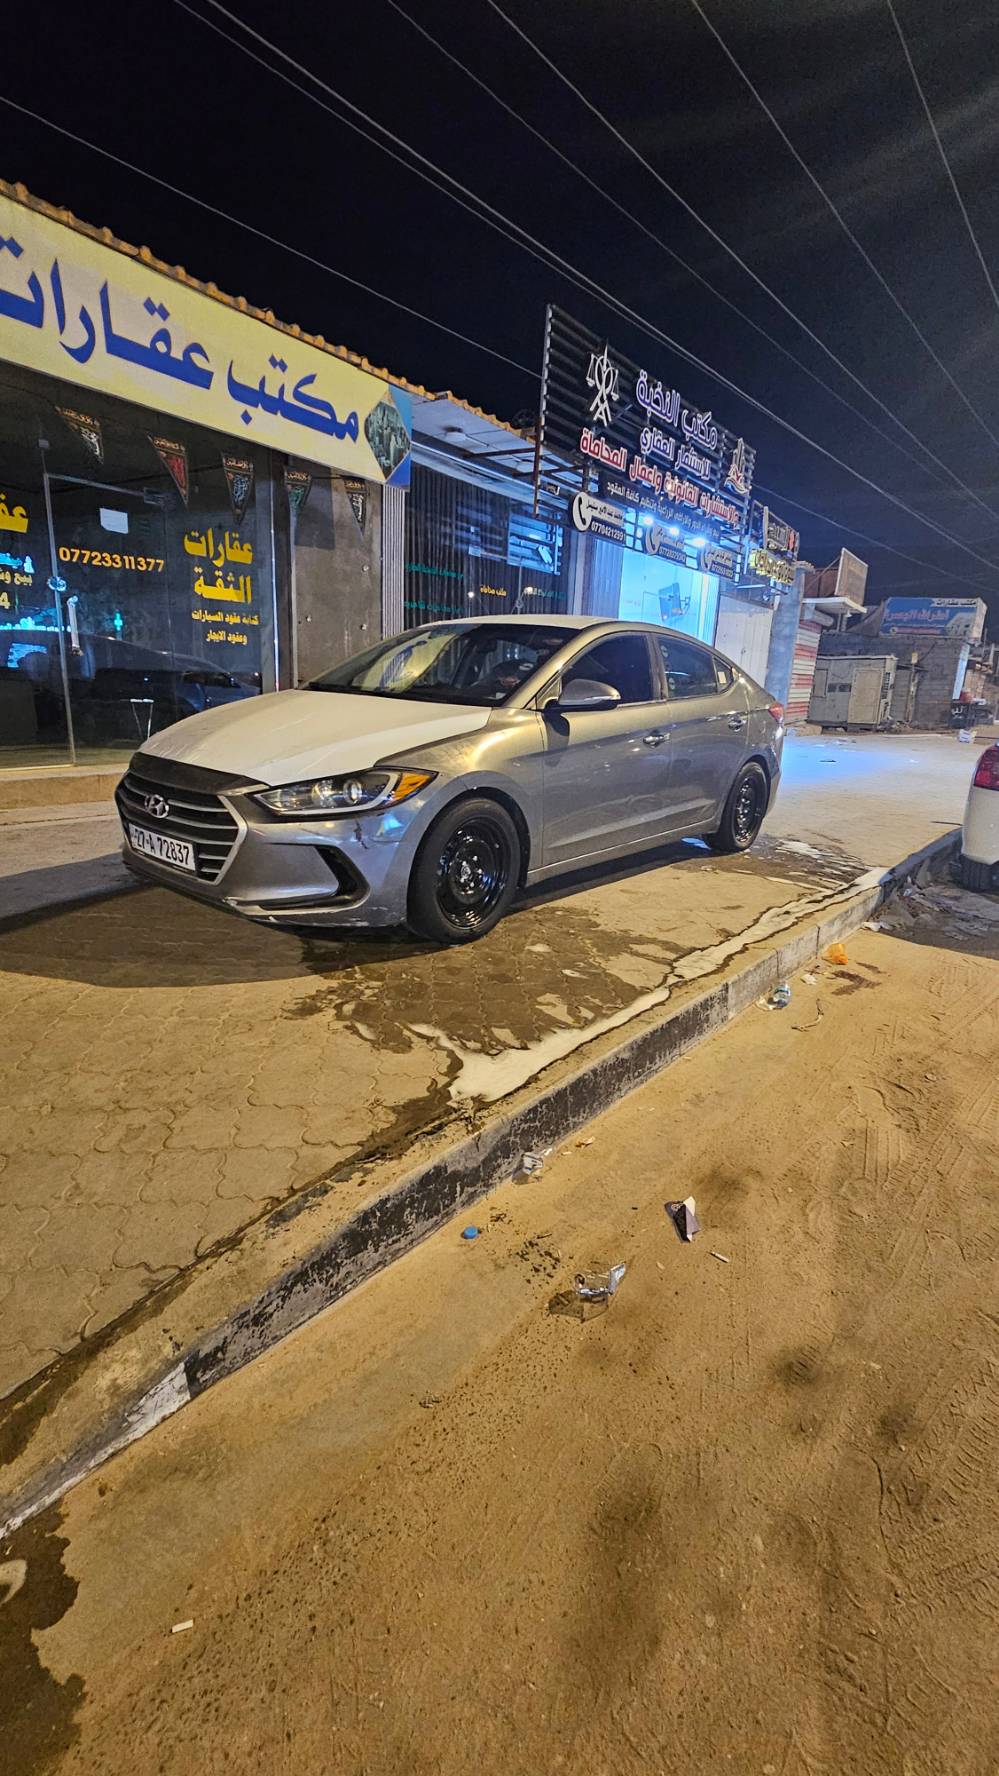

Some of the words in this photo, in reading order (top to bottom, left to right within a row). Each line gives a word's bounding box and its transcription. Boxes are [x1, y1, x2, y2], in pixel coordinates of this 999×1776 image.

[226, 354, 360, 444] مكتب
[636, 369, 680, 427] النخبة
[580, 427, 628, 473] المحاماة
[640, 427, 675, 462] العقاري
[682, 411, 718, 450] مكتب
[607, 480, 626, 497] العقود
[625, 487, 640, 502] كافة
[58, 546, 165, 573] 07723311377
[183, 527, 254, 567] عقارات
[193, 566, 253, 605] الثقة
[191, 609, 224, 624] السيارات
